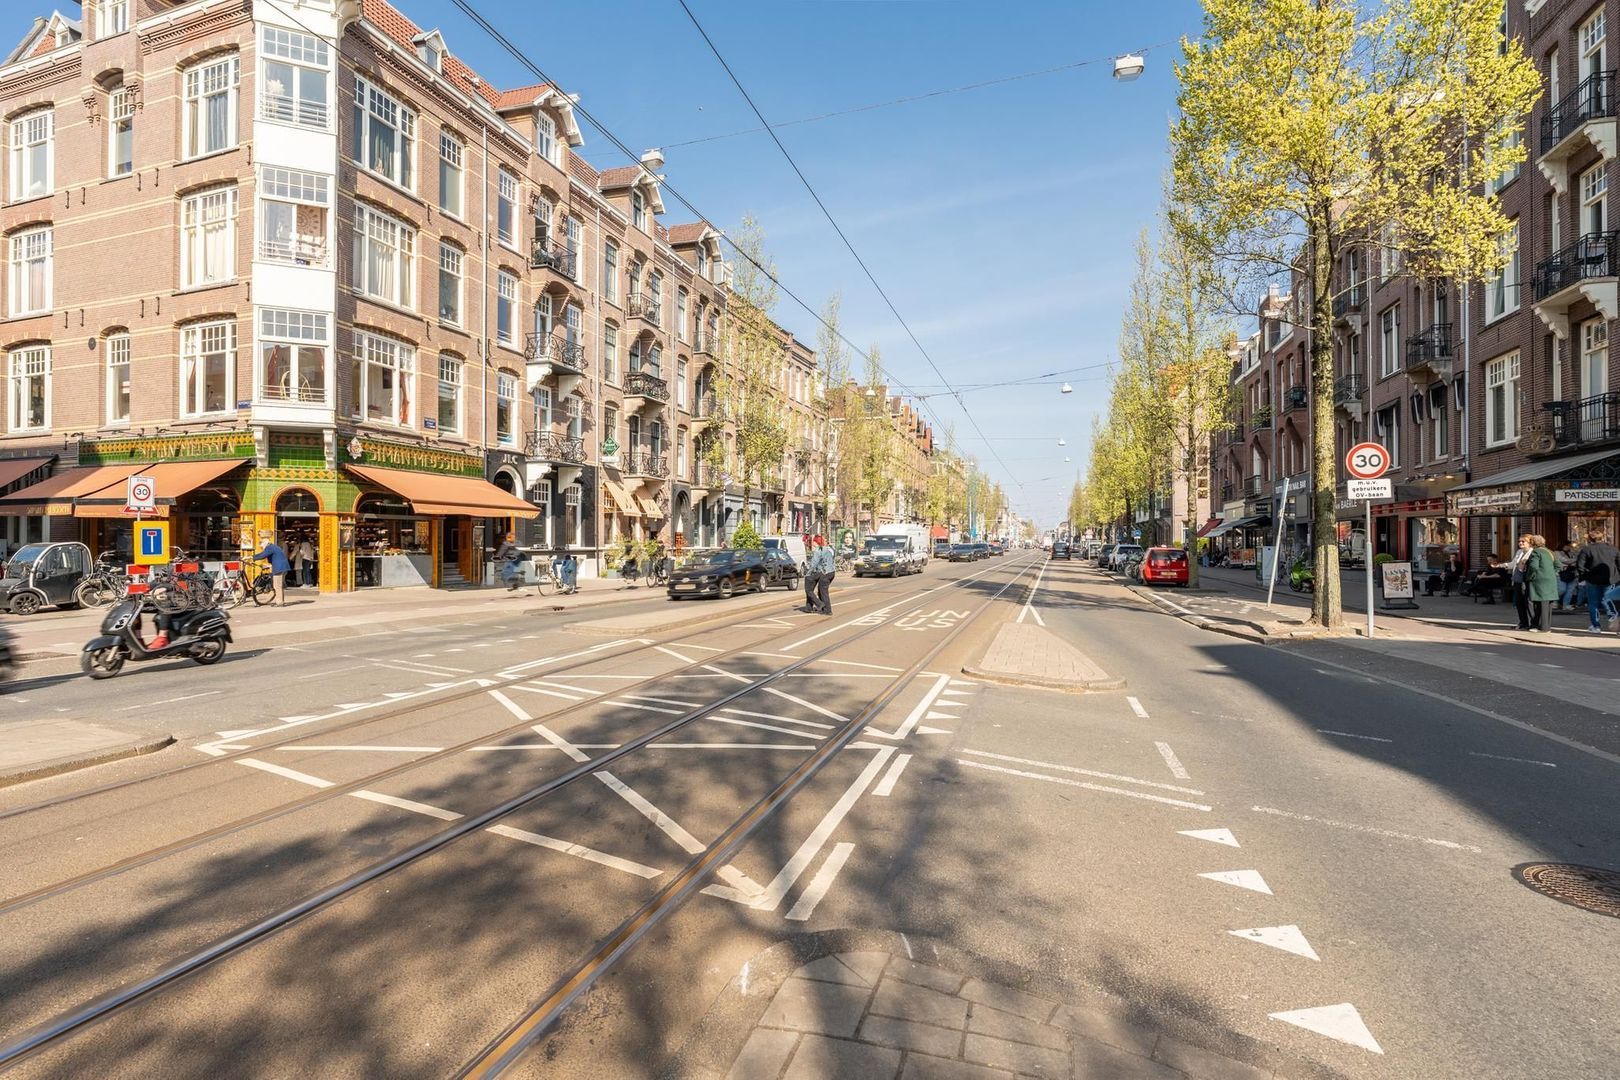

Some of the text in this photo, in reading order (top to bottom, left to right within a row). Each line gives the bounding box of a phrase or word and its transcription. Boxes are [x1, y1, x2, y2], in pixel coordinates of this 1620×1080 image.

[138, 444, 176, 459] SIMON
[370, 447, 411, 466] SIMON
[1355, 454, 1382, 468] 30
[136, 488, 148, 496] 30
[1352, 485, 1387, 493] gebruikers
[1564, 491, 1618, 500] PATISSERIE
[852, 616, 958, 628] BUS
